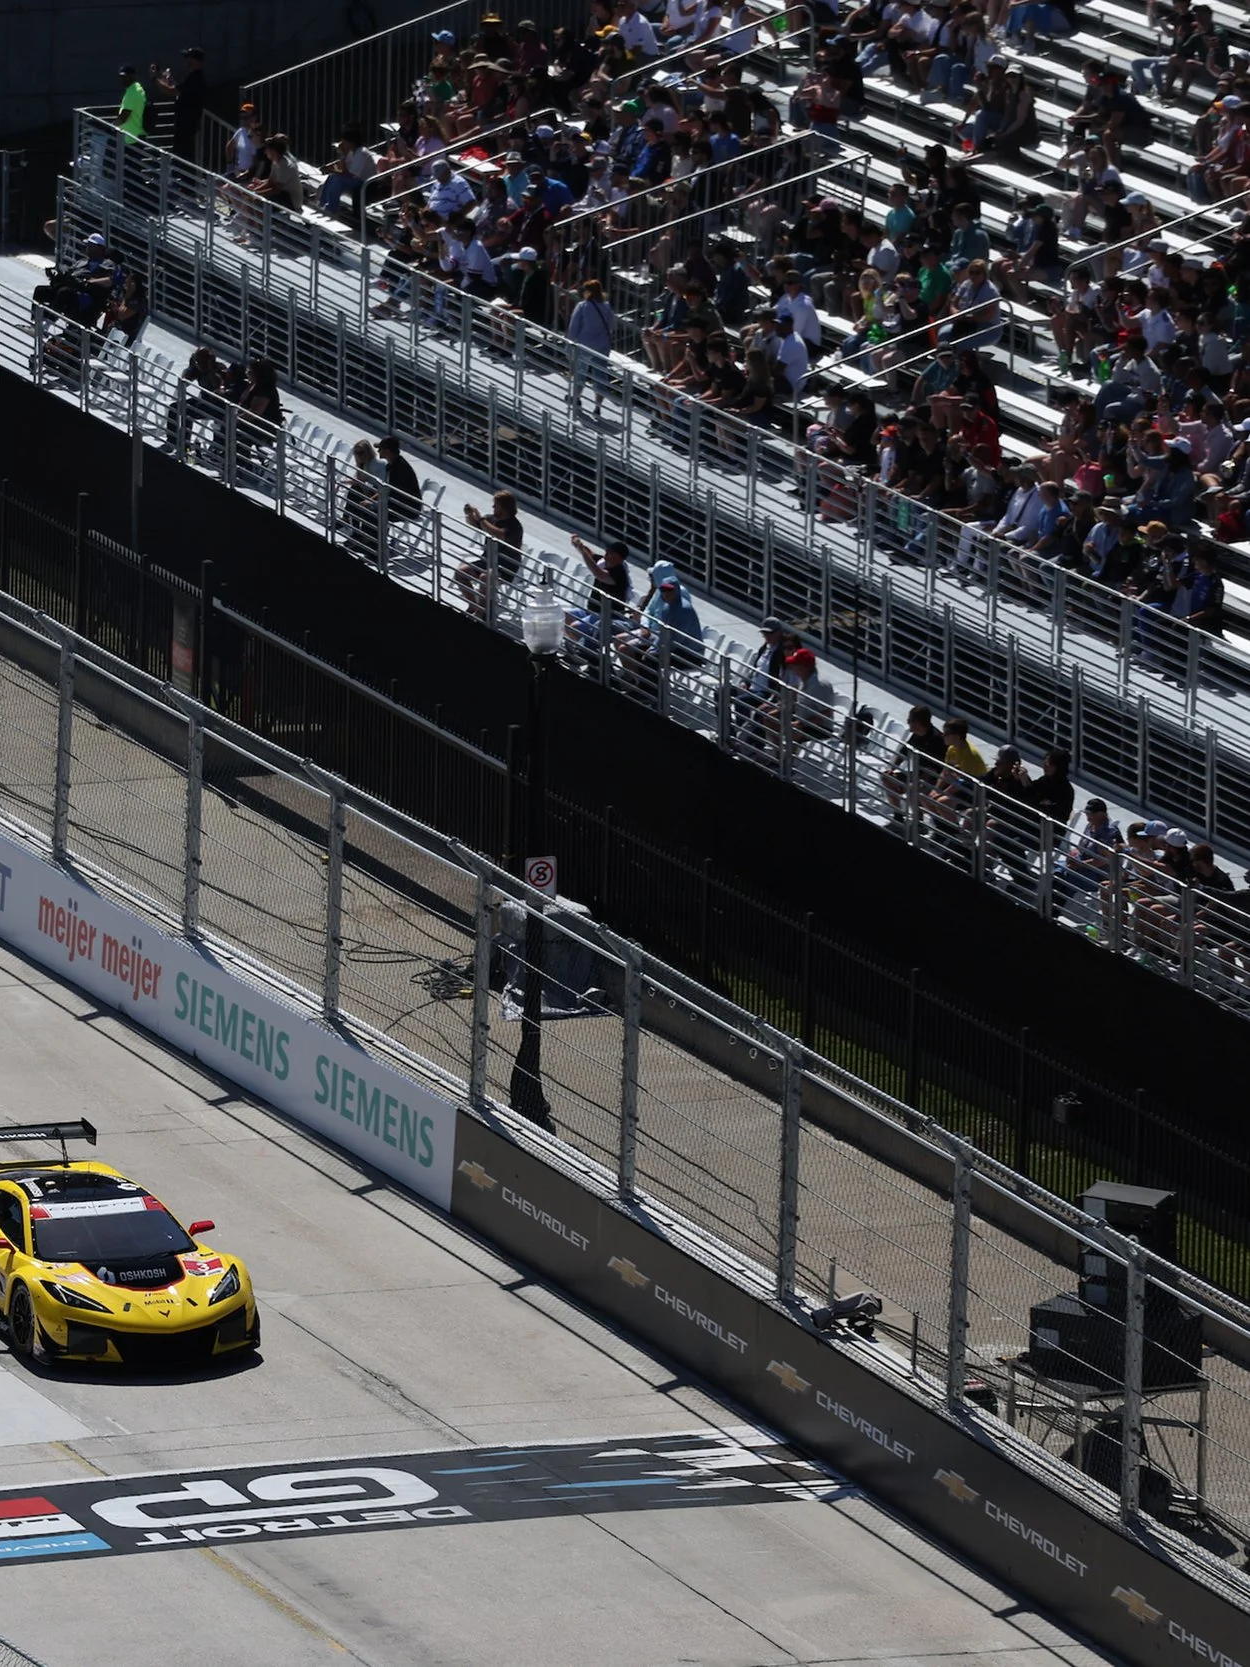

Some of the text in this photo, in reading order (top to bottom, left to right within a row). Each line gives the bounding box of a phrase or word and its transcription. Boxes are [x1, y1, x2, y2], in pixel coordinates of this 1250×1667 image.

[37, 894, 162, 1001] meijer meijer
[174, 971, 290, 1081] SIEMENS
[314, 1054, 434, 1168] SIEMENS
[502, 1187, 590, 1251] CHEVROLET
[119, 1268, 167, 1282] OSHKOSH
[196, 1262, 210, 1272] 3
[654, 1285, 748, 1354] CHEVROLET
[816, 1390, 916, 1464] CHEVROLET
[90, 1467, 439, 1528] GP
[135, 1505, 474, 1547] DETROIT
[985, 1500, 1088, 1577] CHEVROLET
